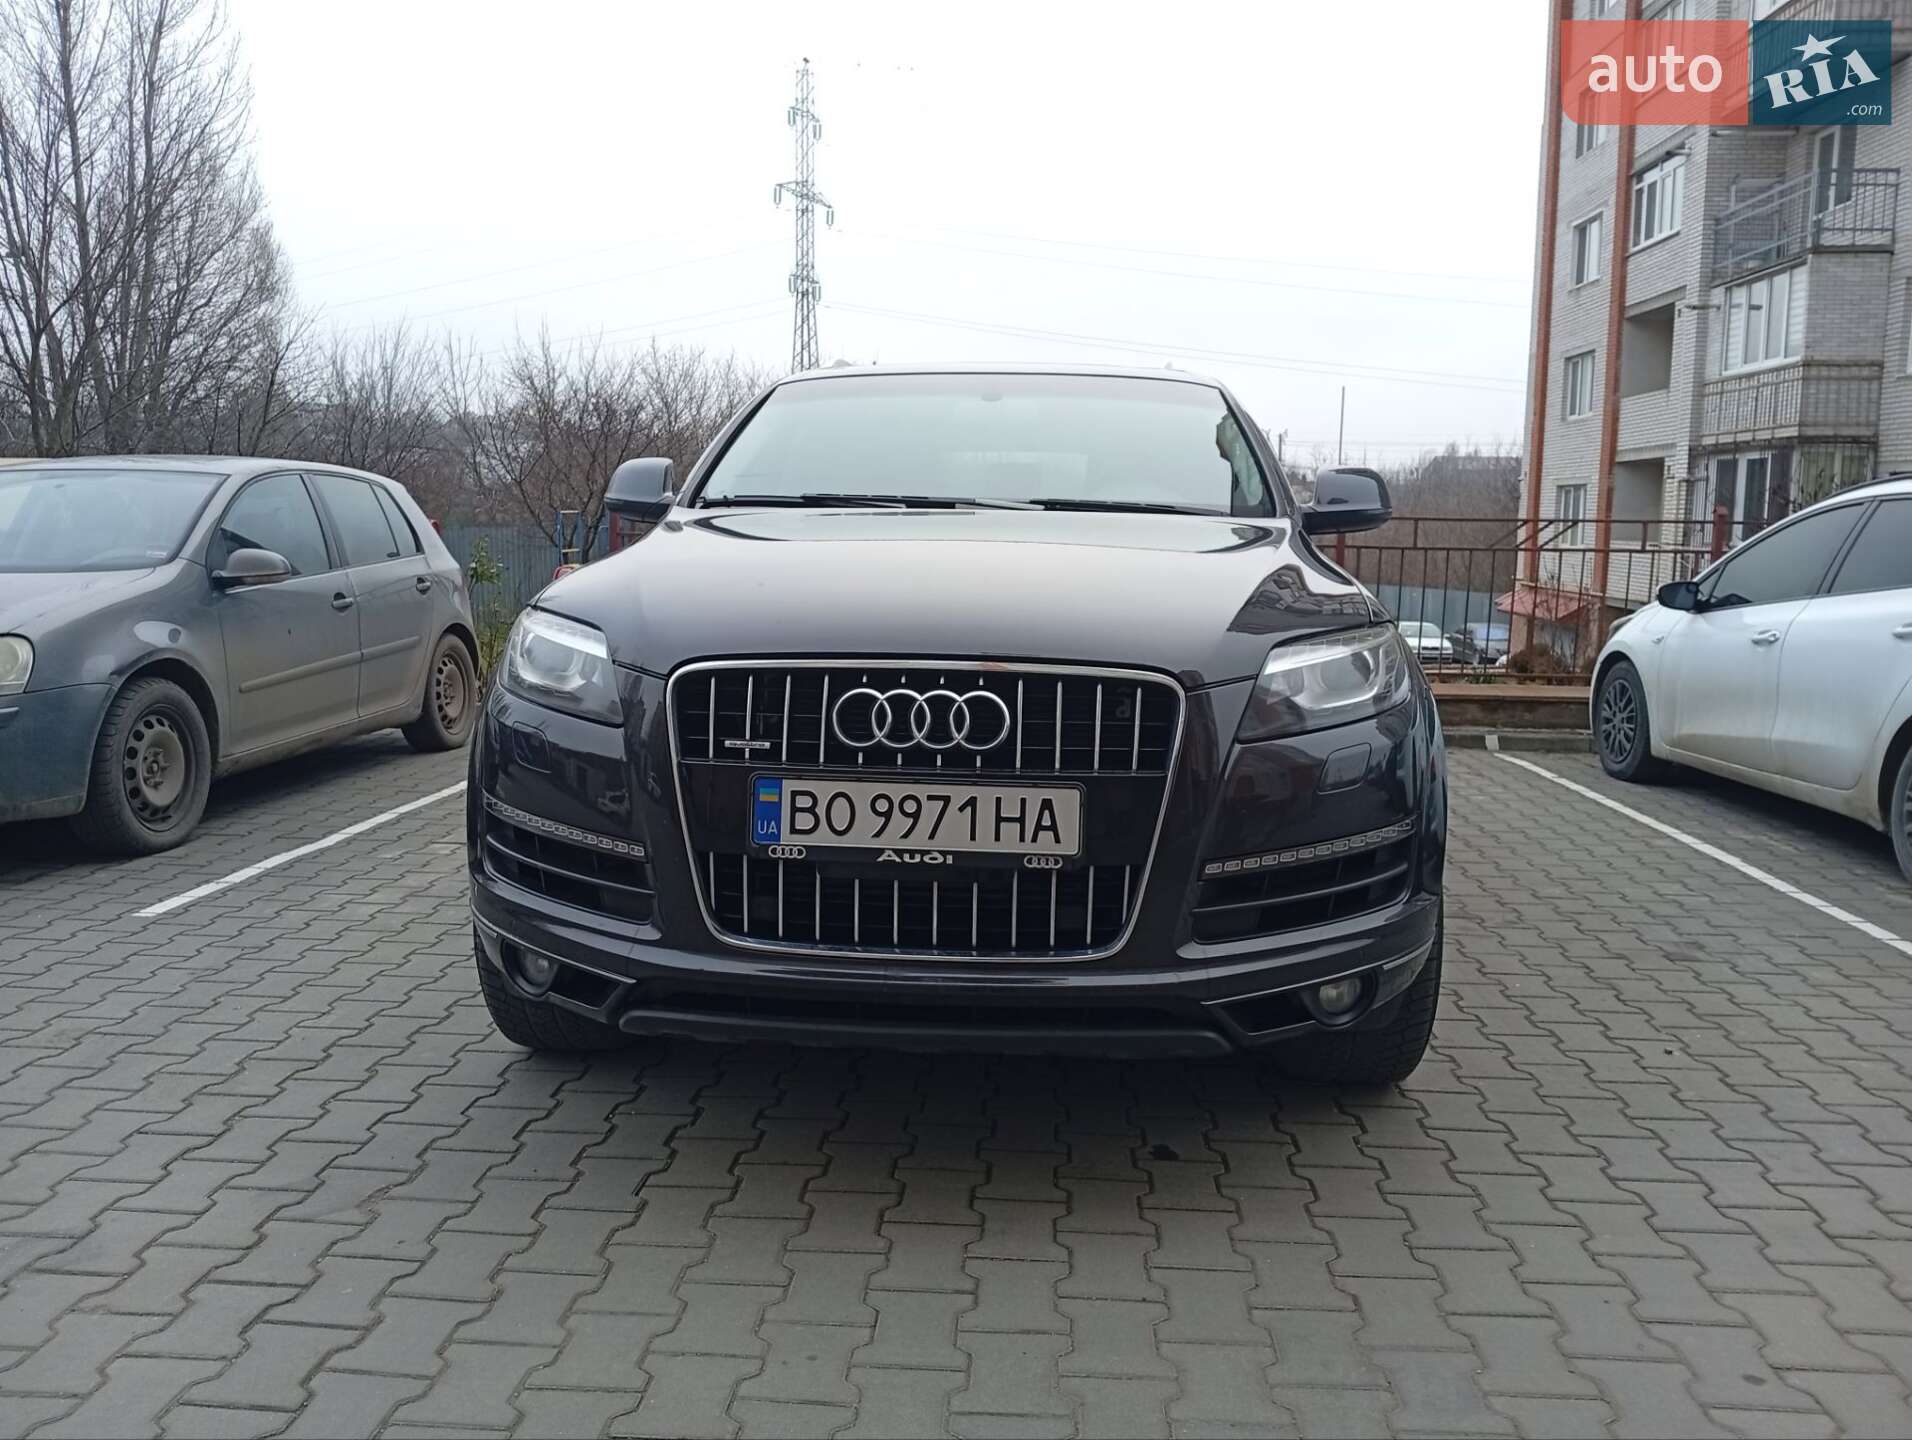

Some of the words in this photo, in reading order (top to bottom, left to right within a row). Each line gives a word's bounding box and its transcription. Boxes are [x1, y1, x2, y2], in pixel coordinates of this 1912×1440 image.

[789, 789, 856, 837] BO
[870, 792, 978, 842] 9971
[994, 796, 1062, 844] HA
[757, 819, 778, 835] UA
[876, 849, 953, 865] Audi
